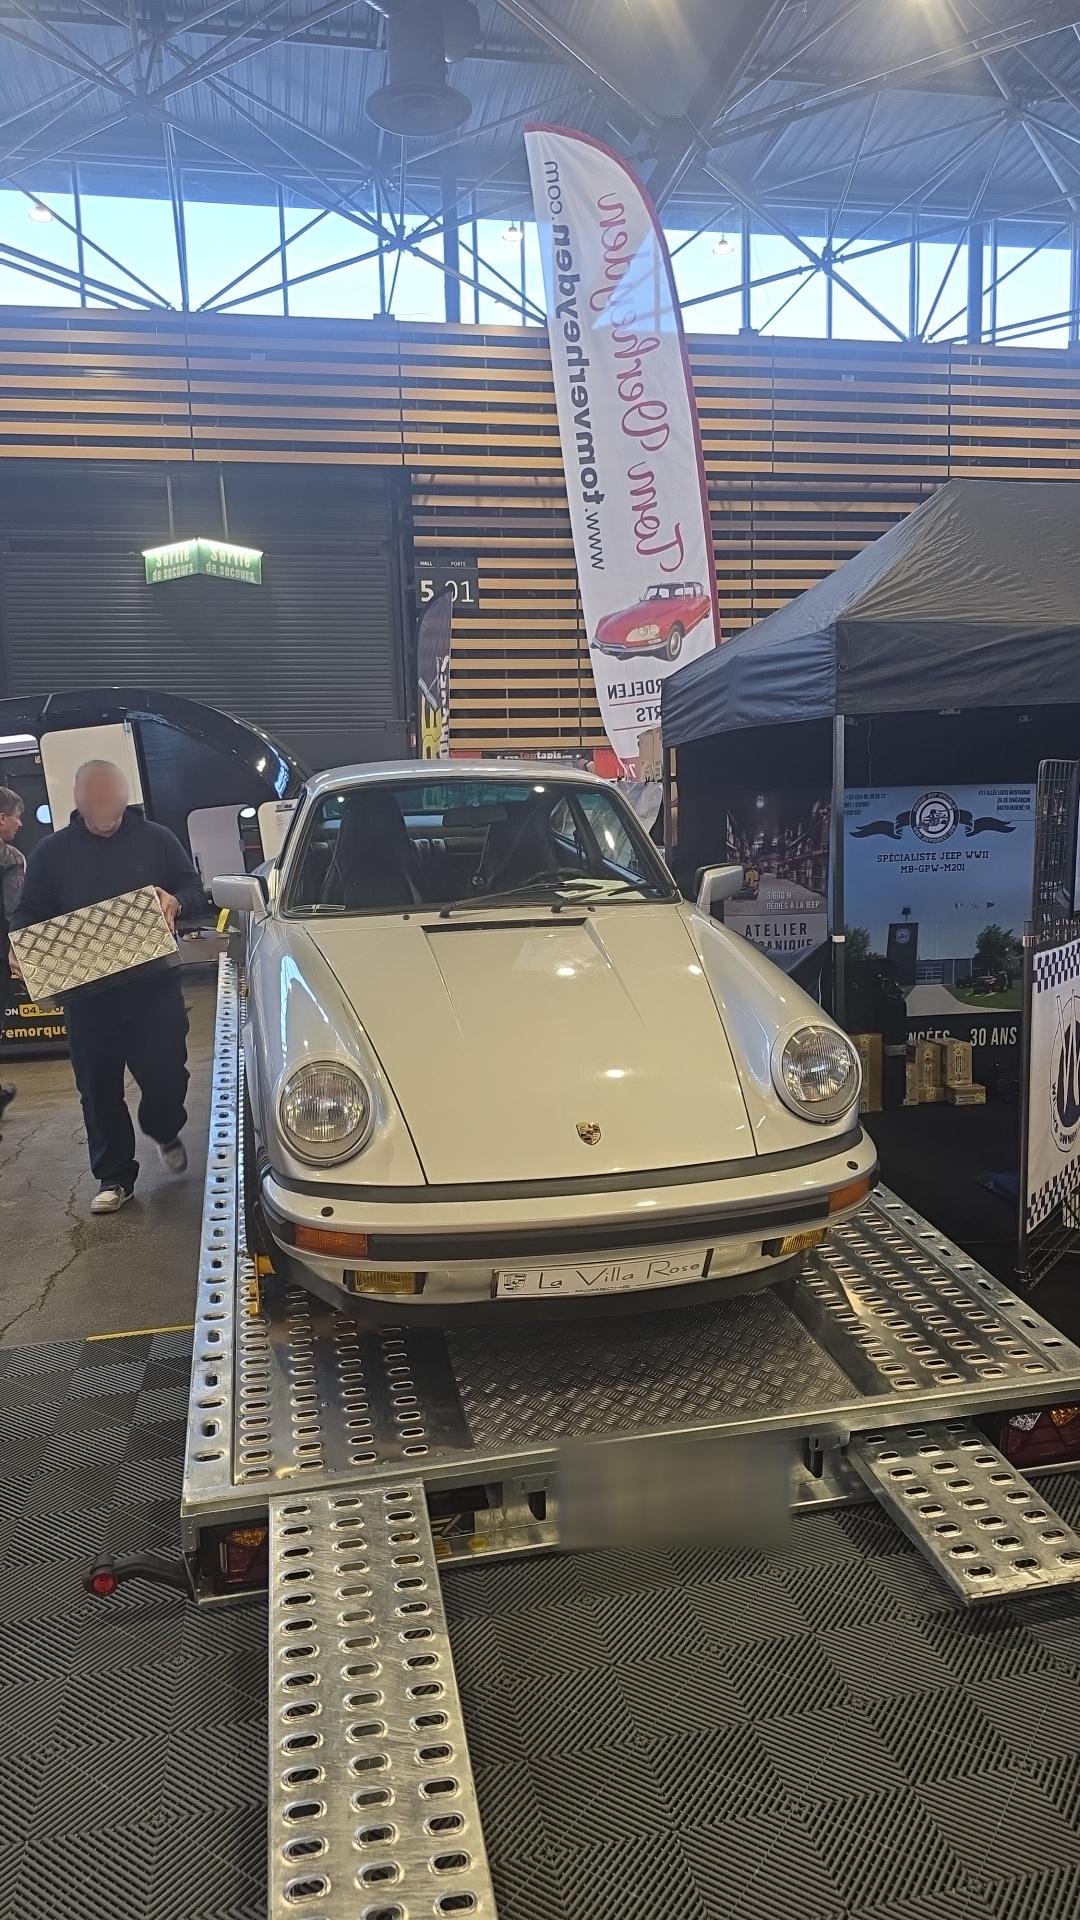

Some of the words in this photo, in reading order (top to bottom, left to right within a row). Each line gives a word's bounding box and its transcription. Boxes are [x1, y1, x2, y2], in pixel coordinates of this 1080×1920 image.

[156, 546, 190, 568] Sortie
[210, 546, 251, 569] Sortie
[152, 569, 162, 582] de
[164, 562, 194, 580] secours
[205, 561, 217, 574] de
[219, 564, 255, 582] secours
[420, 580, 435, 603] 5
[940, 851, 962, 860] JEEP
[965, 850, 989, 859] WWII
[805, 900, 820, 909] JEEP
[745, 922, 808, 938] ATELIER
[970, 1028, 987, 1047] 30
[990, 1026, 1018, 1046] ANS
[538, 1272, 563, 1290] La
[575, 1266, 634, 1286] Villa
[646, 1260, 701, 1279] Rose
